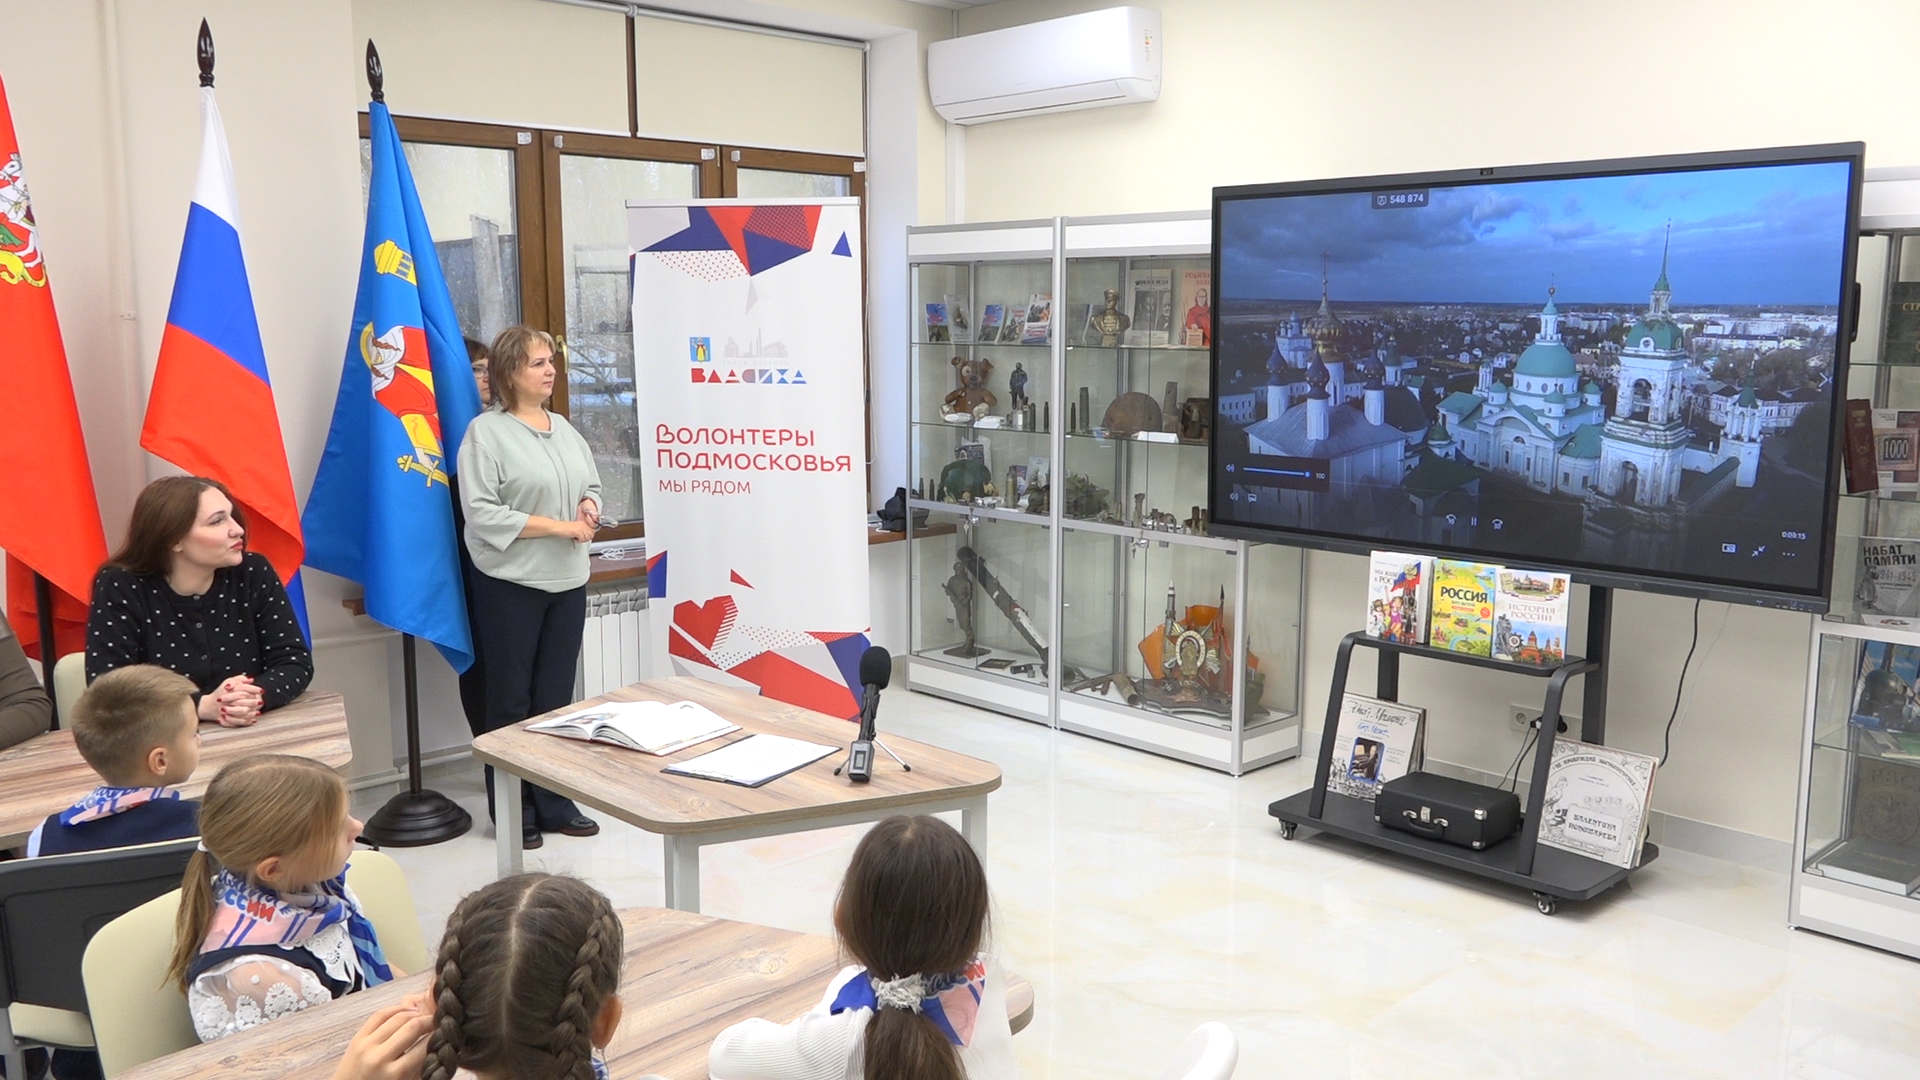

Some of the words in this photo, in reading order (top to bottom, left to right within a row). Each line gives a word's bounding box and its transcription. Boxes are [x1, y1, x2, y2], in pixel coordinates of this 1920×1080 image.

[1390, 194, 1406, 204] 548
[1407, 193, 1424, 203] 874
[691, 368, 807, 385] ВЛАСИХА
[656, 424, 814, 446] ВОЛОНТЕРЫ
[1884, 439, 1909, 459] 1000
[657, 449, 851, 472] ПОДМОСКОВЬЯ
[1315, 472, 1326, 480] 100
[659, 480, 687, 493] МЫ
[691, 480, 751, 496] РЯДОМ
[1863, 544, 1903, 556] НАБАТ
[1864, 554, 1916, 567] ПАМЯТИ
[1879, 569, 1917, 582] 941-1945
[1440, 586, 1488, 604] РОССИЯ
[1508, 603, 1556, 615] ИСТОРИЯ
[1511, 611, 1553, 622] РОССИИ
[214, 883, 276, 922] ОССИИ
